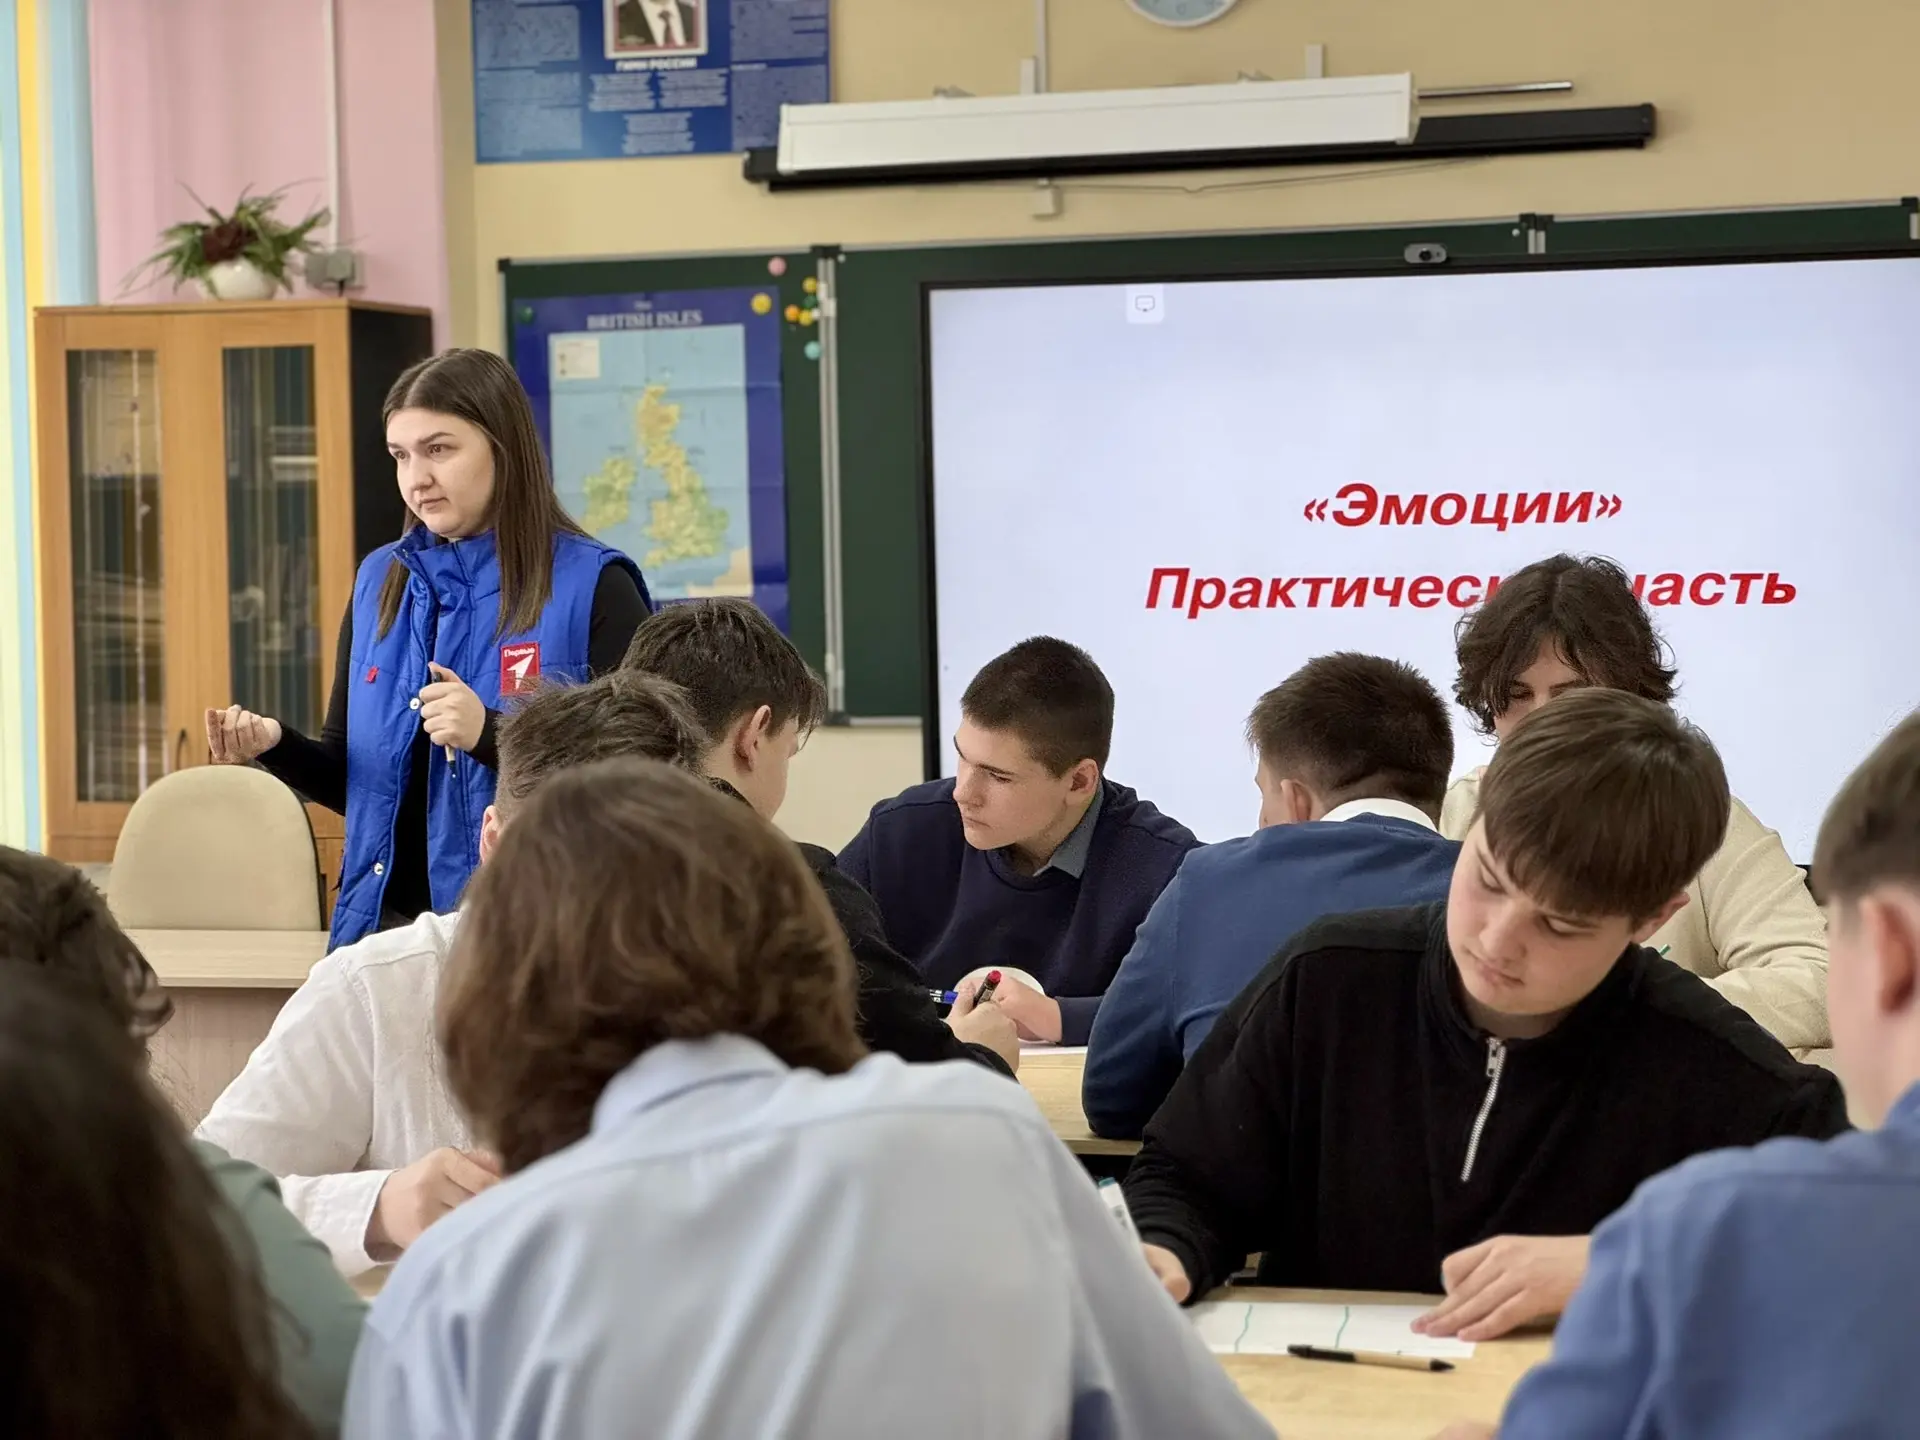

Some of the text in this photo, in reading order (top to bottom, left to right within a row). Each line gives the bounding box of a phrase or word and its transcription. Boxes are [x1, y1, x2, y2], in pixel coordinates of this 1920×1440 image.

[649, 56, 697, 70] РОССИИ
[587, 309, 703, 330] BRITISH ISLES
[1303, 483, 1622, 532] «Эмоции»
[1146, 567, 1501, 620] Практичес
